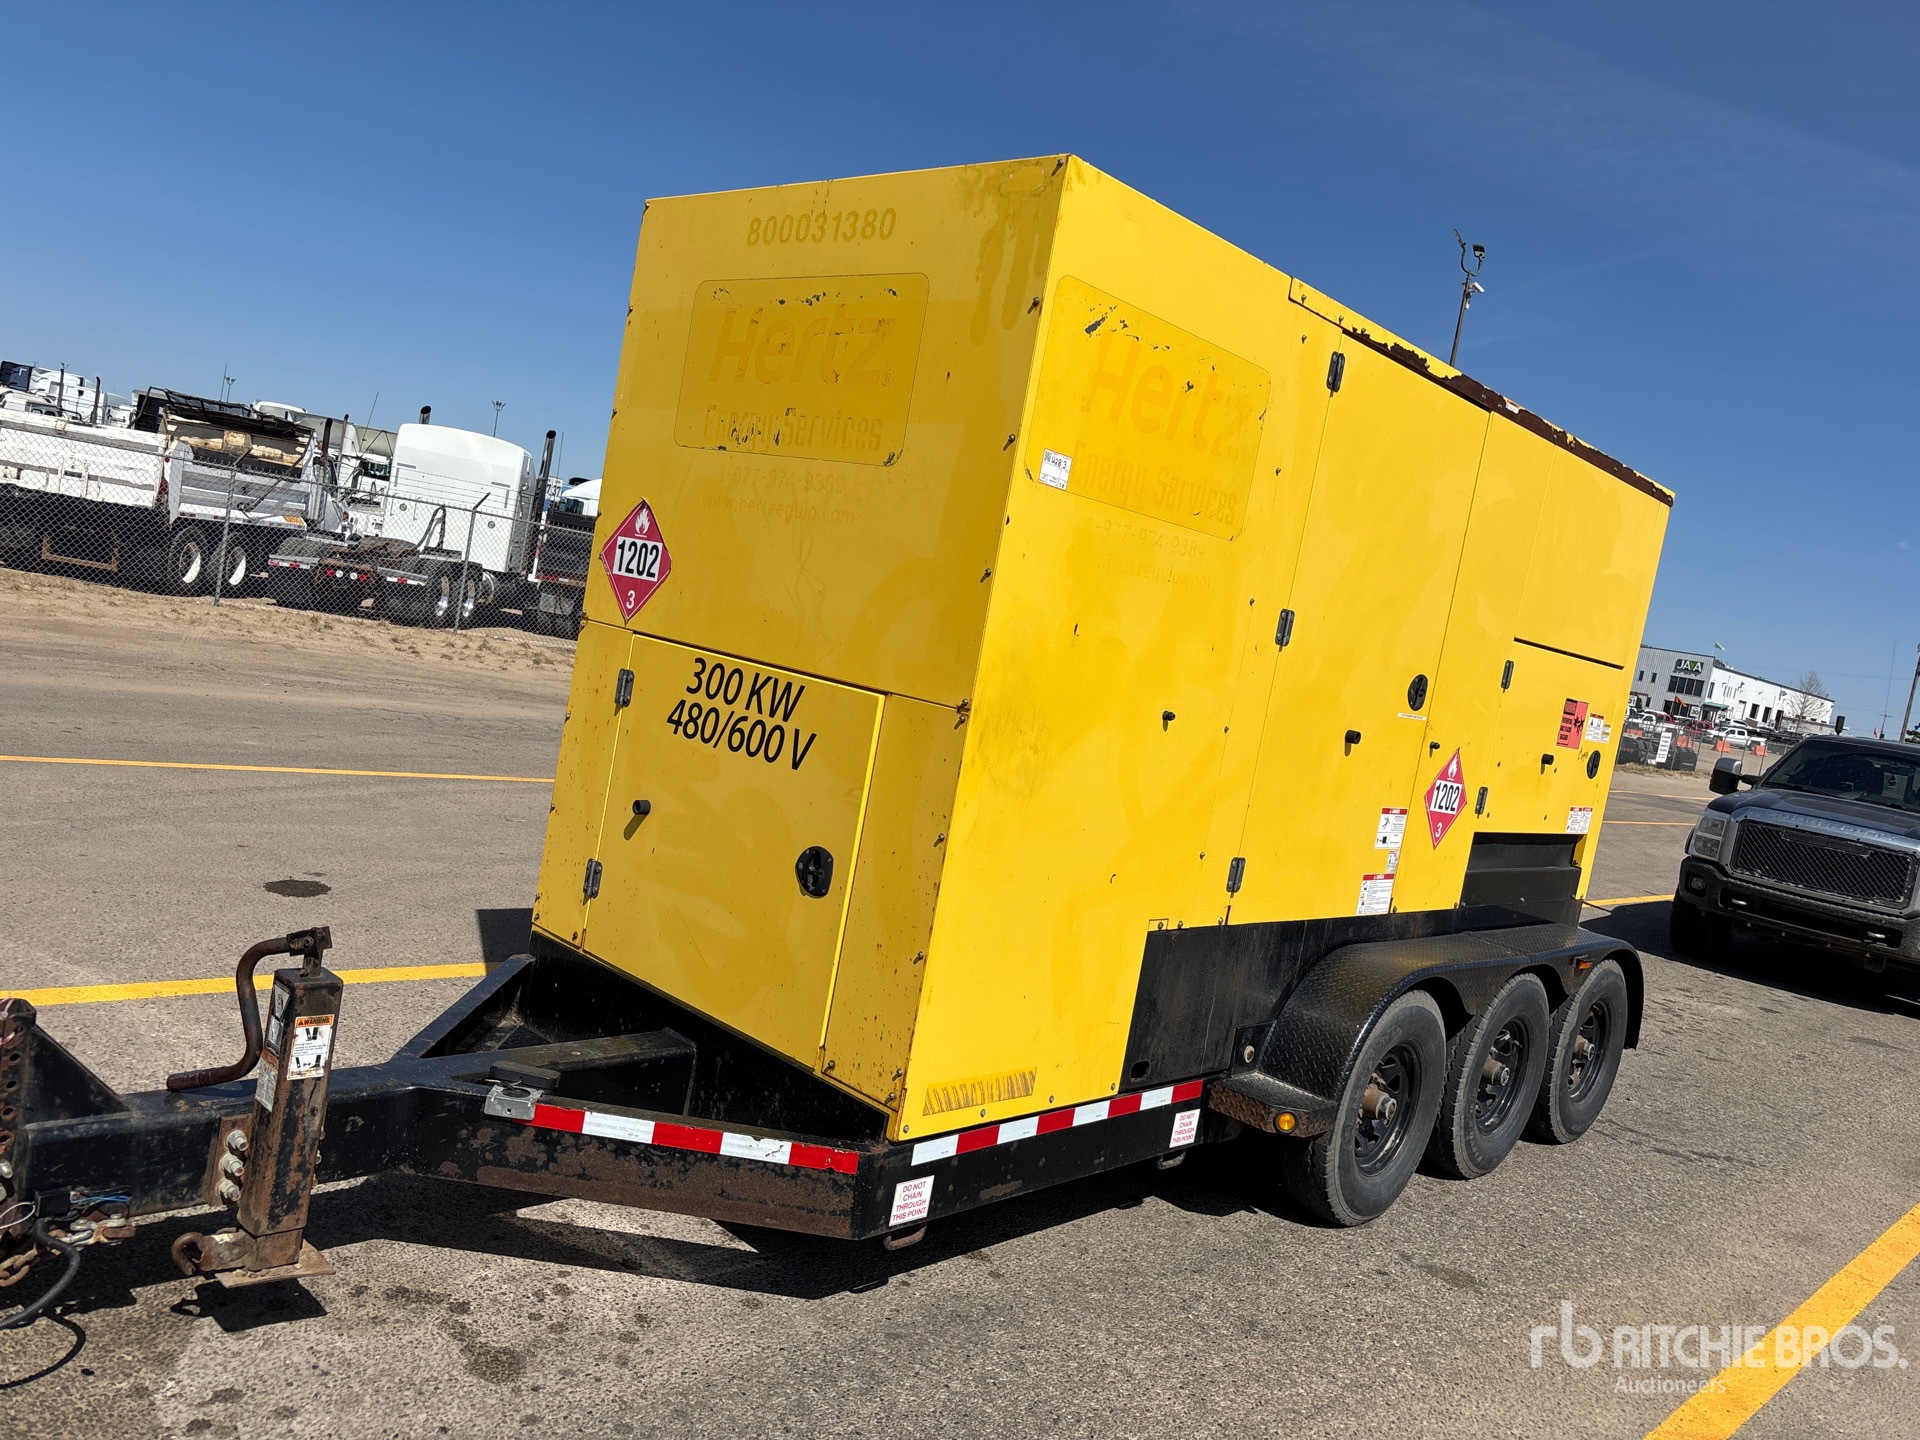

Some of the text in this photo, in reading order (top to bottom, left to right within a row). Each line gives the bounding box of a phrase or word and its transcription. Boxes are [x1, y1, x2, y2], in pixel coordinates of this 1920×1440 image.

[747, 207, 897, 248] 800031380
[707, 303, 898, 386] Hertz
[1081, 329, 1251, 459] Hertz
[703, 405, 884, 453] Energy Services
[617, 538, 662, 579] 1202
[626, 589, 637, 610] 3
[686, 657, 806, 723] 300 KW
[666, 699, 817, 771] 480/600 V
[1435, 783, 1460, 812] 1202
[1435, 823, 1443, 838] 3
[1174, 1127, 1194, 1136] THROUGH
[902, 1180, 927, 1193] DO NOT
[902, 1191, 923, 1202] CHAIN
[892, 1206, 927, 1222] THIS POINT
[895, 1199, 927, 1212] THROUGH
